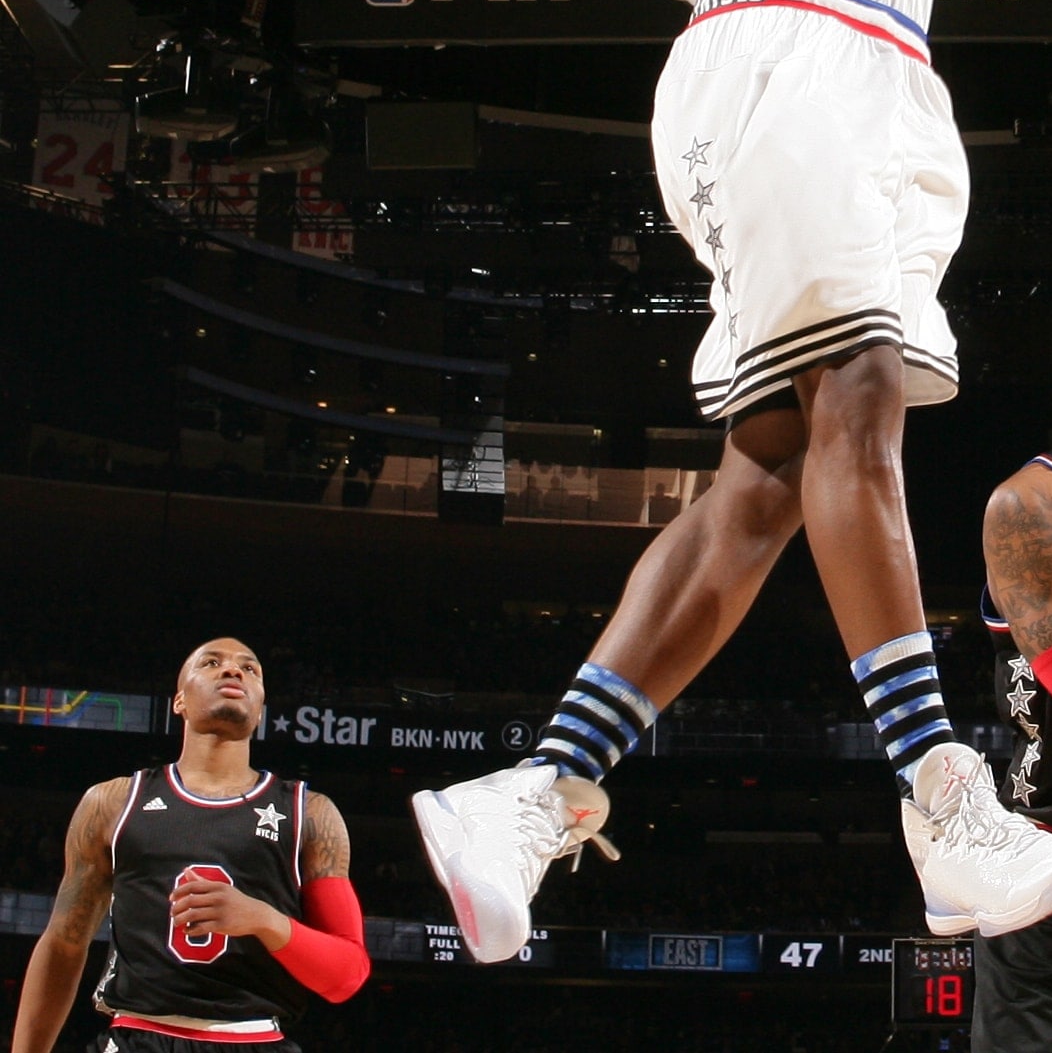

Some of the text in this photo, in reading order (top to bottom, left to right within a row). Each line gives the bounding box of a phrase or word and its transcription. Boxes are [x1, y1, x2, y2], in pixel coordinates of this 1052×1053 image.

[295, 705, 377, 746] Star
[509, 727, 523, 745] 2
[255, 827, 270, 839] NYC
[429, 938, 460, 949] FULL
[519, 945, 532, 962] 0
[664, 939, 709, 966] EAST
[434, 951, 454, 961] :20
[780, 942, 823, 967] 47
[925, 975, 962, 1016] 18
